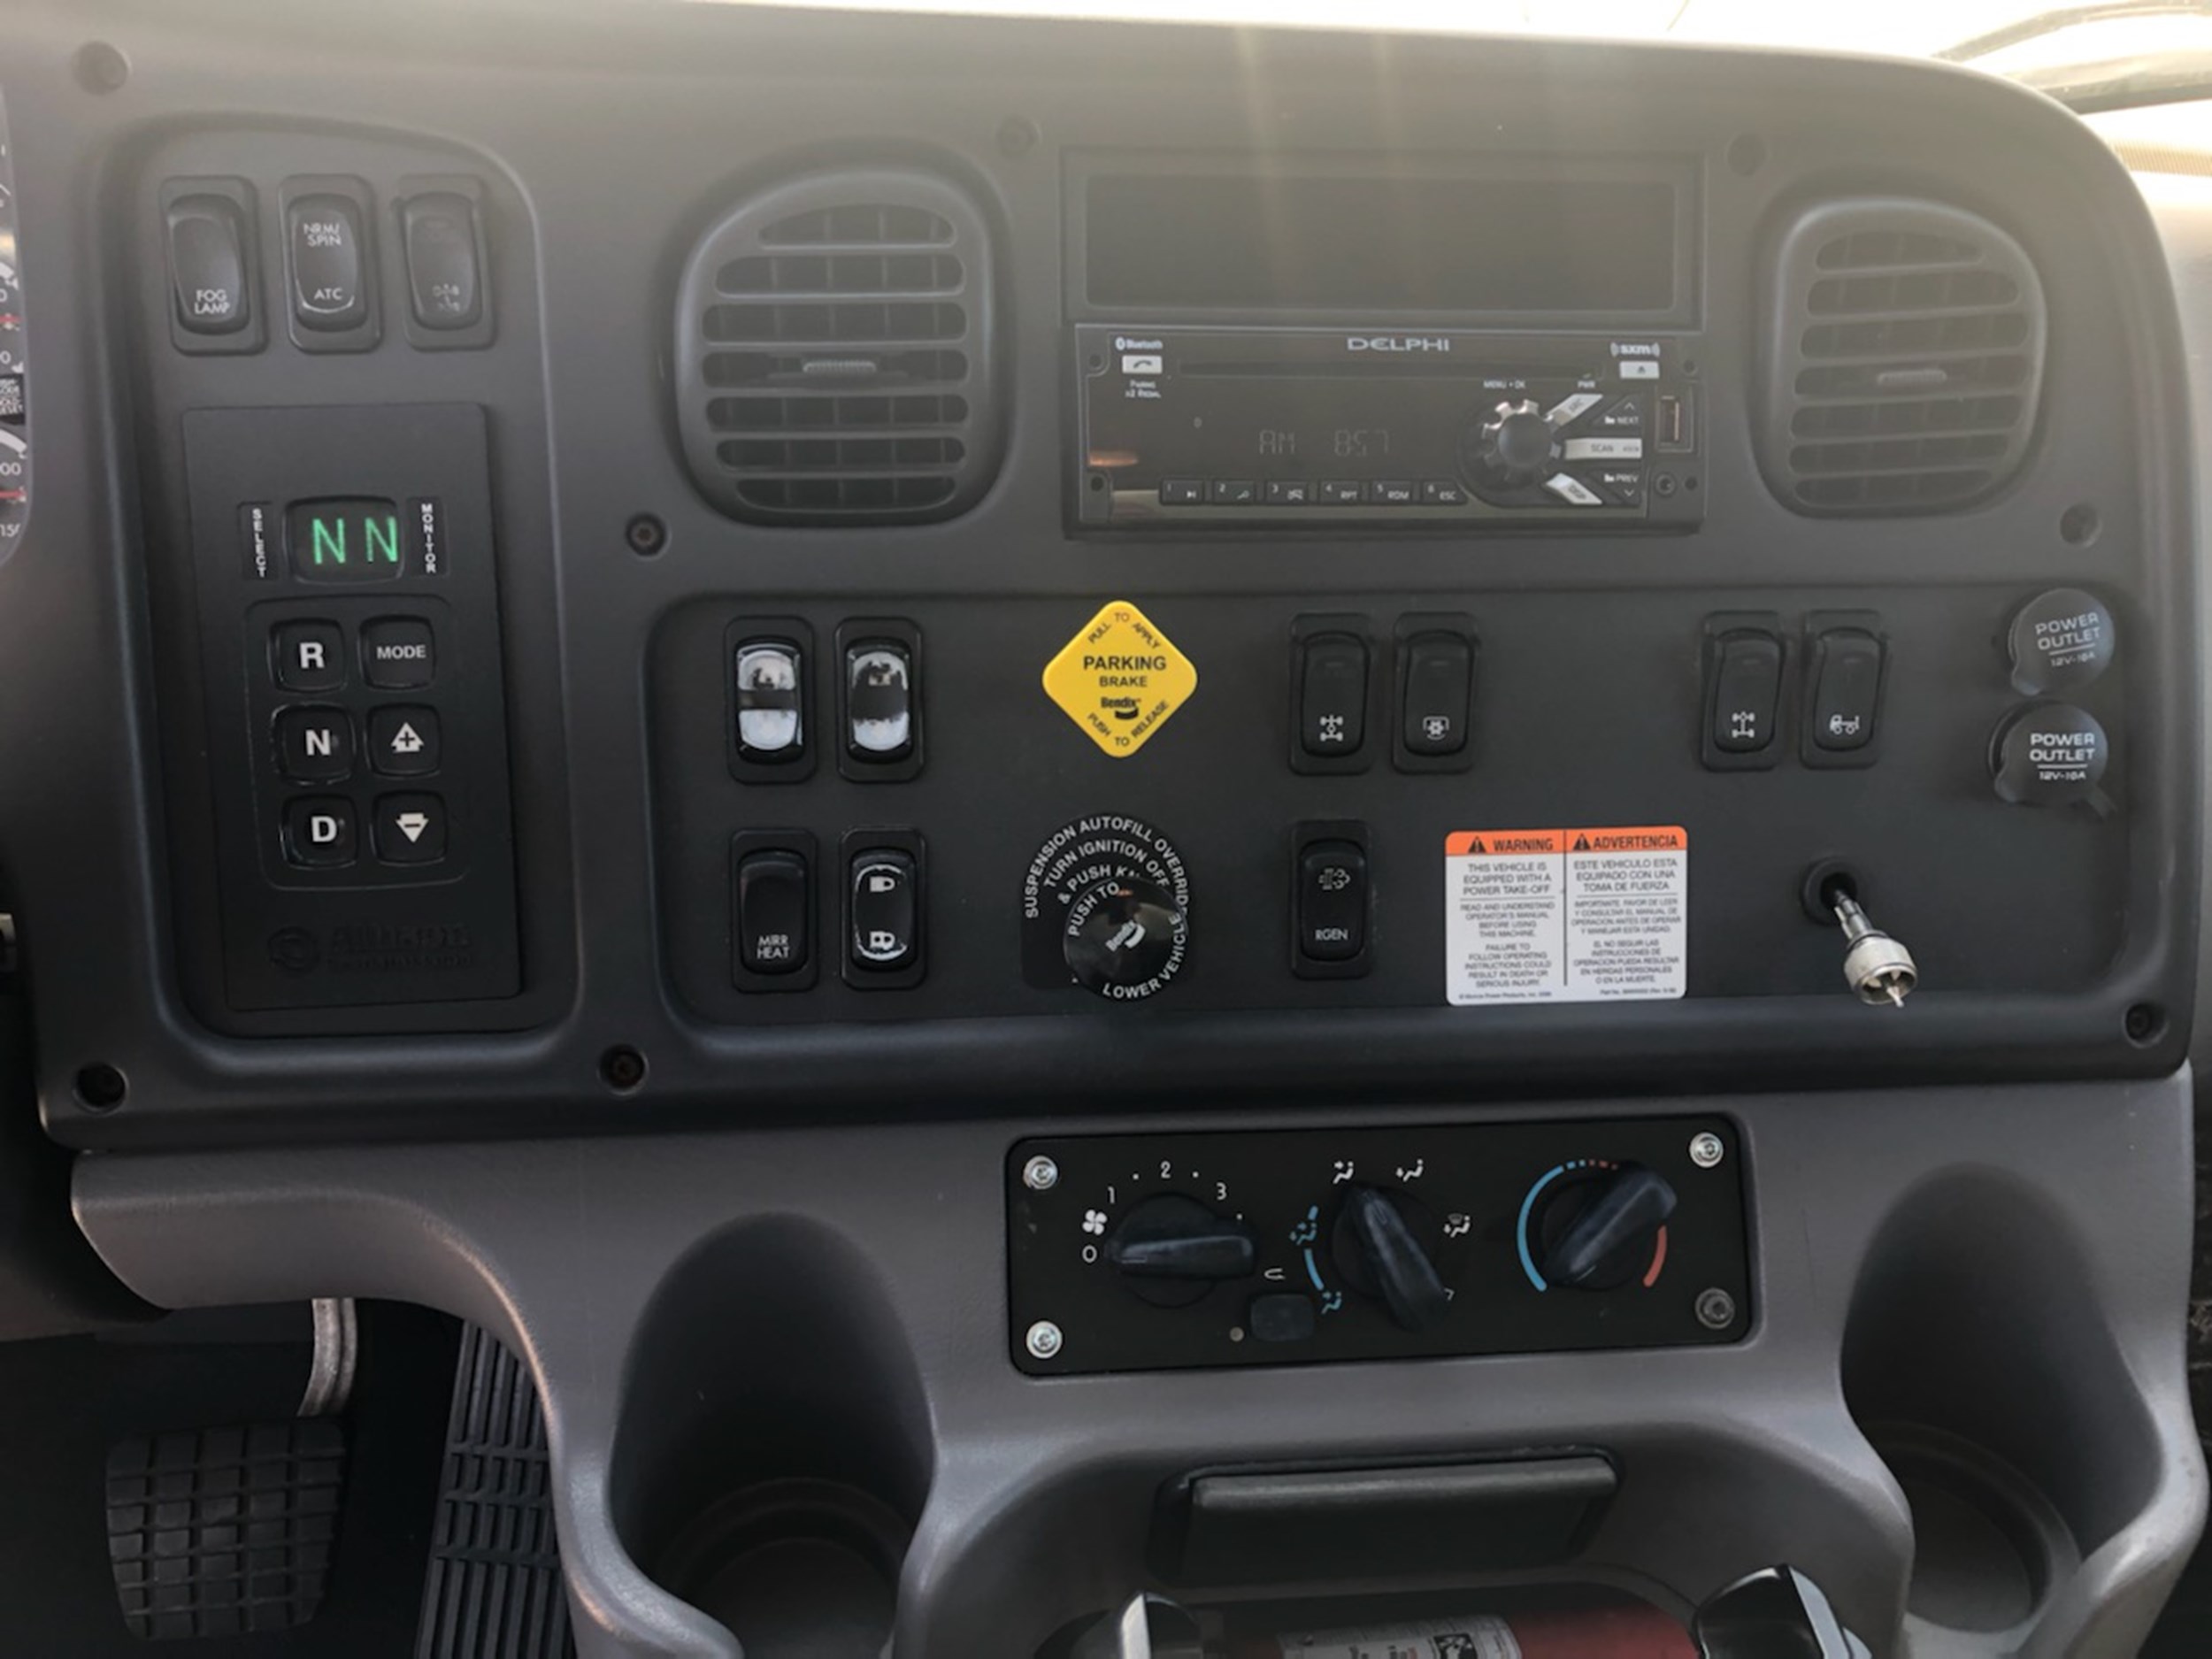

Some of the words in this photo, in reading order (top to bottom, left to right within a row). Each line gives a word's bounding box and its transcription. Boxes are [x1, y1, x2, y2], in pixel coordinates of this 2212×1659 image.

[303, 223, 340, 235] NRM/
[307, 234, 342, 247] SPIN
[196, 289, 227, 302] FOG
[314, 288, 342, 301] ATC
[194, 303, 230, 315] LAMP
[1348, 337, 1450, 352] DELPHI
[1483, 380, 1507, 389] MENU
[1617, 416, 1639, 425] NEXT
[1259, 429, 1295, 456] AM
[1591, 444, 1614, 453] SCAN
[252, 508, 265, 578] SELECT
[312, 517, 346, 565] N
[365, 515, 398, 564] N
[420, 502, 437, 574] MONITOR
[2035, 612, 2100, 634] POWER
[1087, 623, 1111, 644] PULL
[1115, 612, 1130, 622] TO
[1133, 622, 1161, 649] APPLY
[2037, 626, 2101, 650] OUTLET
[299, 641, 326, 669] R
[376, 645, 426, 661] MODE
[1083, 656, 1167, 671] PARKING
[1099, 676, 1148, 687] BRAKE
[1101, 697, 1137, 709] Bendix
[1087, 712, 1112, 737] PUSH
[1115, 736, 1131, 747] TO
[1131, 700, 1170, 739] RELEASE
[304, 729, 332, 757] N
[2030, 733, 2095, 747] POWER
[2029, 748, 2096, 762] OUTLET
[311, 816, 338, 843] D
[1494, 839, 1553, 851] WARNING
[1594, 835, 1678, 849] ADVERTENCIA
[1025, 826, 1077, 918] SUSPENSION
[1079, 816, 1153, 842] AUTOFILL
[1043, 850, 1079, 888] TURN
[1079, 840, 1148, 863] IGNITION
[1145, 860, 1171, 887] OFF
[1468, 864, 1490, 872] THIS
[1493, 863, 1534, 872] VEHICLE
[1537, 862, 1547, 871] IS
[1574, 860, 1598, 869] ESTE
[1601, 859, 1651, 869] VEHICULO
[1654, 858, 1677, 867] ESTA
[1066, 865, 1111, 892] PUSH
[1463, 873, 1514, 884] EQUIPPED
[1517, 873, 1542, 882] WITH
[1576, 871, 1627, 881] EQUIPADO
[1629, 871, 1652, 879] CON
[1463, 886, 1501, 895] POWER
[1503, 885, 1550, 894] TAKE-OFF
[1584, 883, 1611, 892] TOMA
[1615, 882, 1627, 891] DE
[1631, 881, 1669, 891] FUERZA
[1067, 895, 1098, 936] PUSH
[1097, 881, 1120, 898] TO
[1502, 902, 1555, 910] UNDERSTAND
[757, 934, 789, 948] MIRR
[1105, 920, 1136, 951] Bendix
[1315, 927, 1348, 941] RGEN
[757, 947, 790, 959] HEAT
[1102, 978, 1162, 999] LOWER
[1159, 912, 1186, 981] VEHICLE
[1503, 951, 1548, 960] OPERATING
[1160, 1161, 1171, 1179] 2
[1108, 1186, 1116, 1204] 1
[1216, 1181, 1227, 1201] 3
